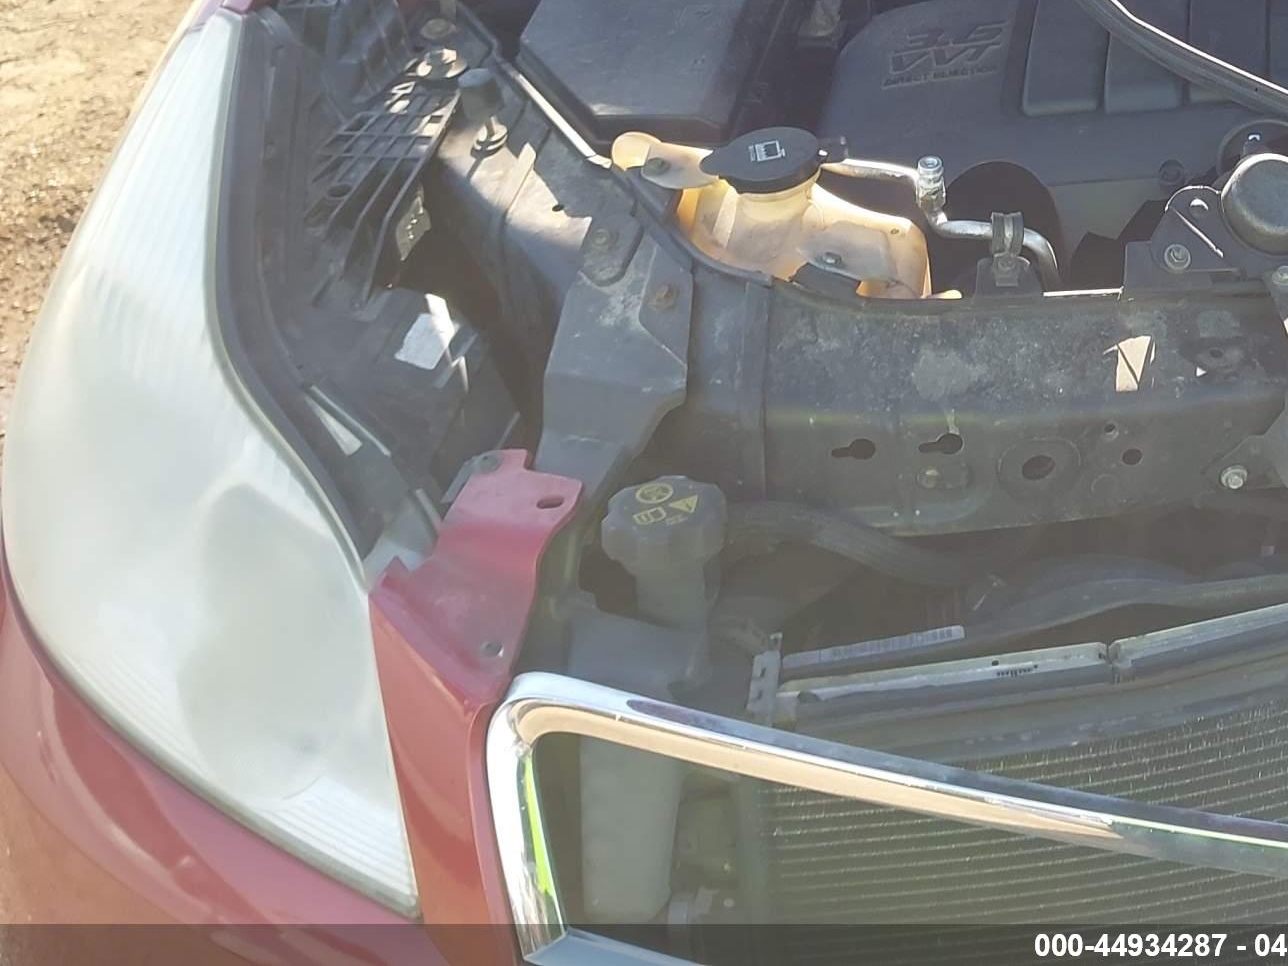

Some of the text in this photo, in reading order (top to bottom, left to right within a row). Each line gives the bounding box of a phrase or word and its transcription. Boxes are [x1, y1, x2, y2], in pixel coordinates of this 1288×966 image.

[904, 21, 1009, 50] 3.6
[888, 42, 1003, 75] VVT
[883, 65, 999, 86] DIRECT INJECTION
